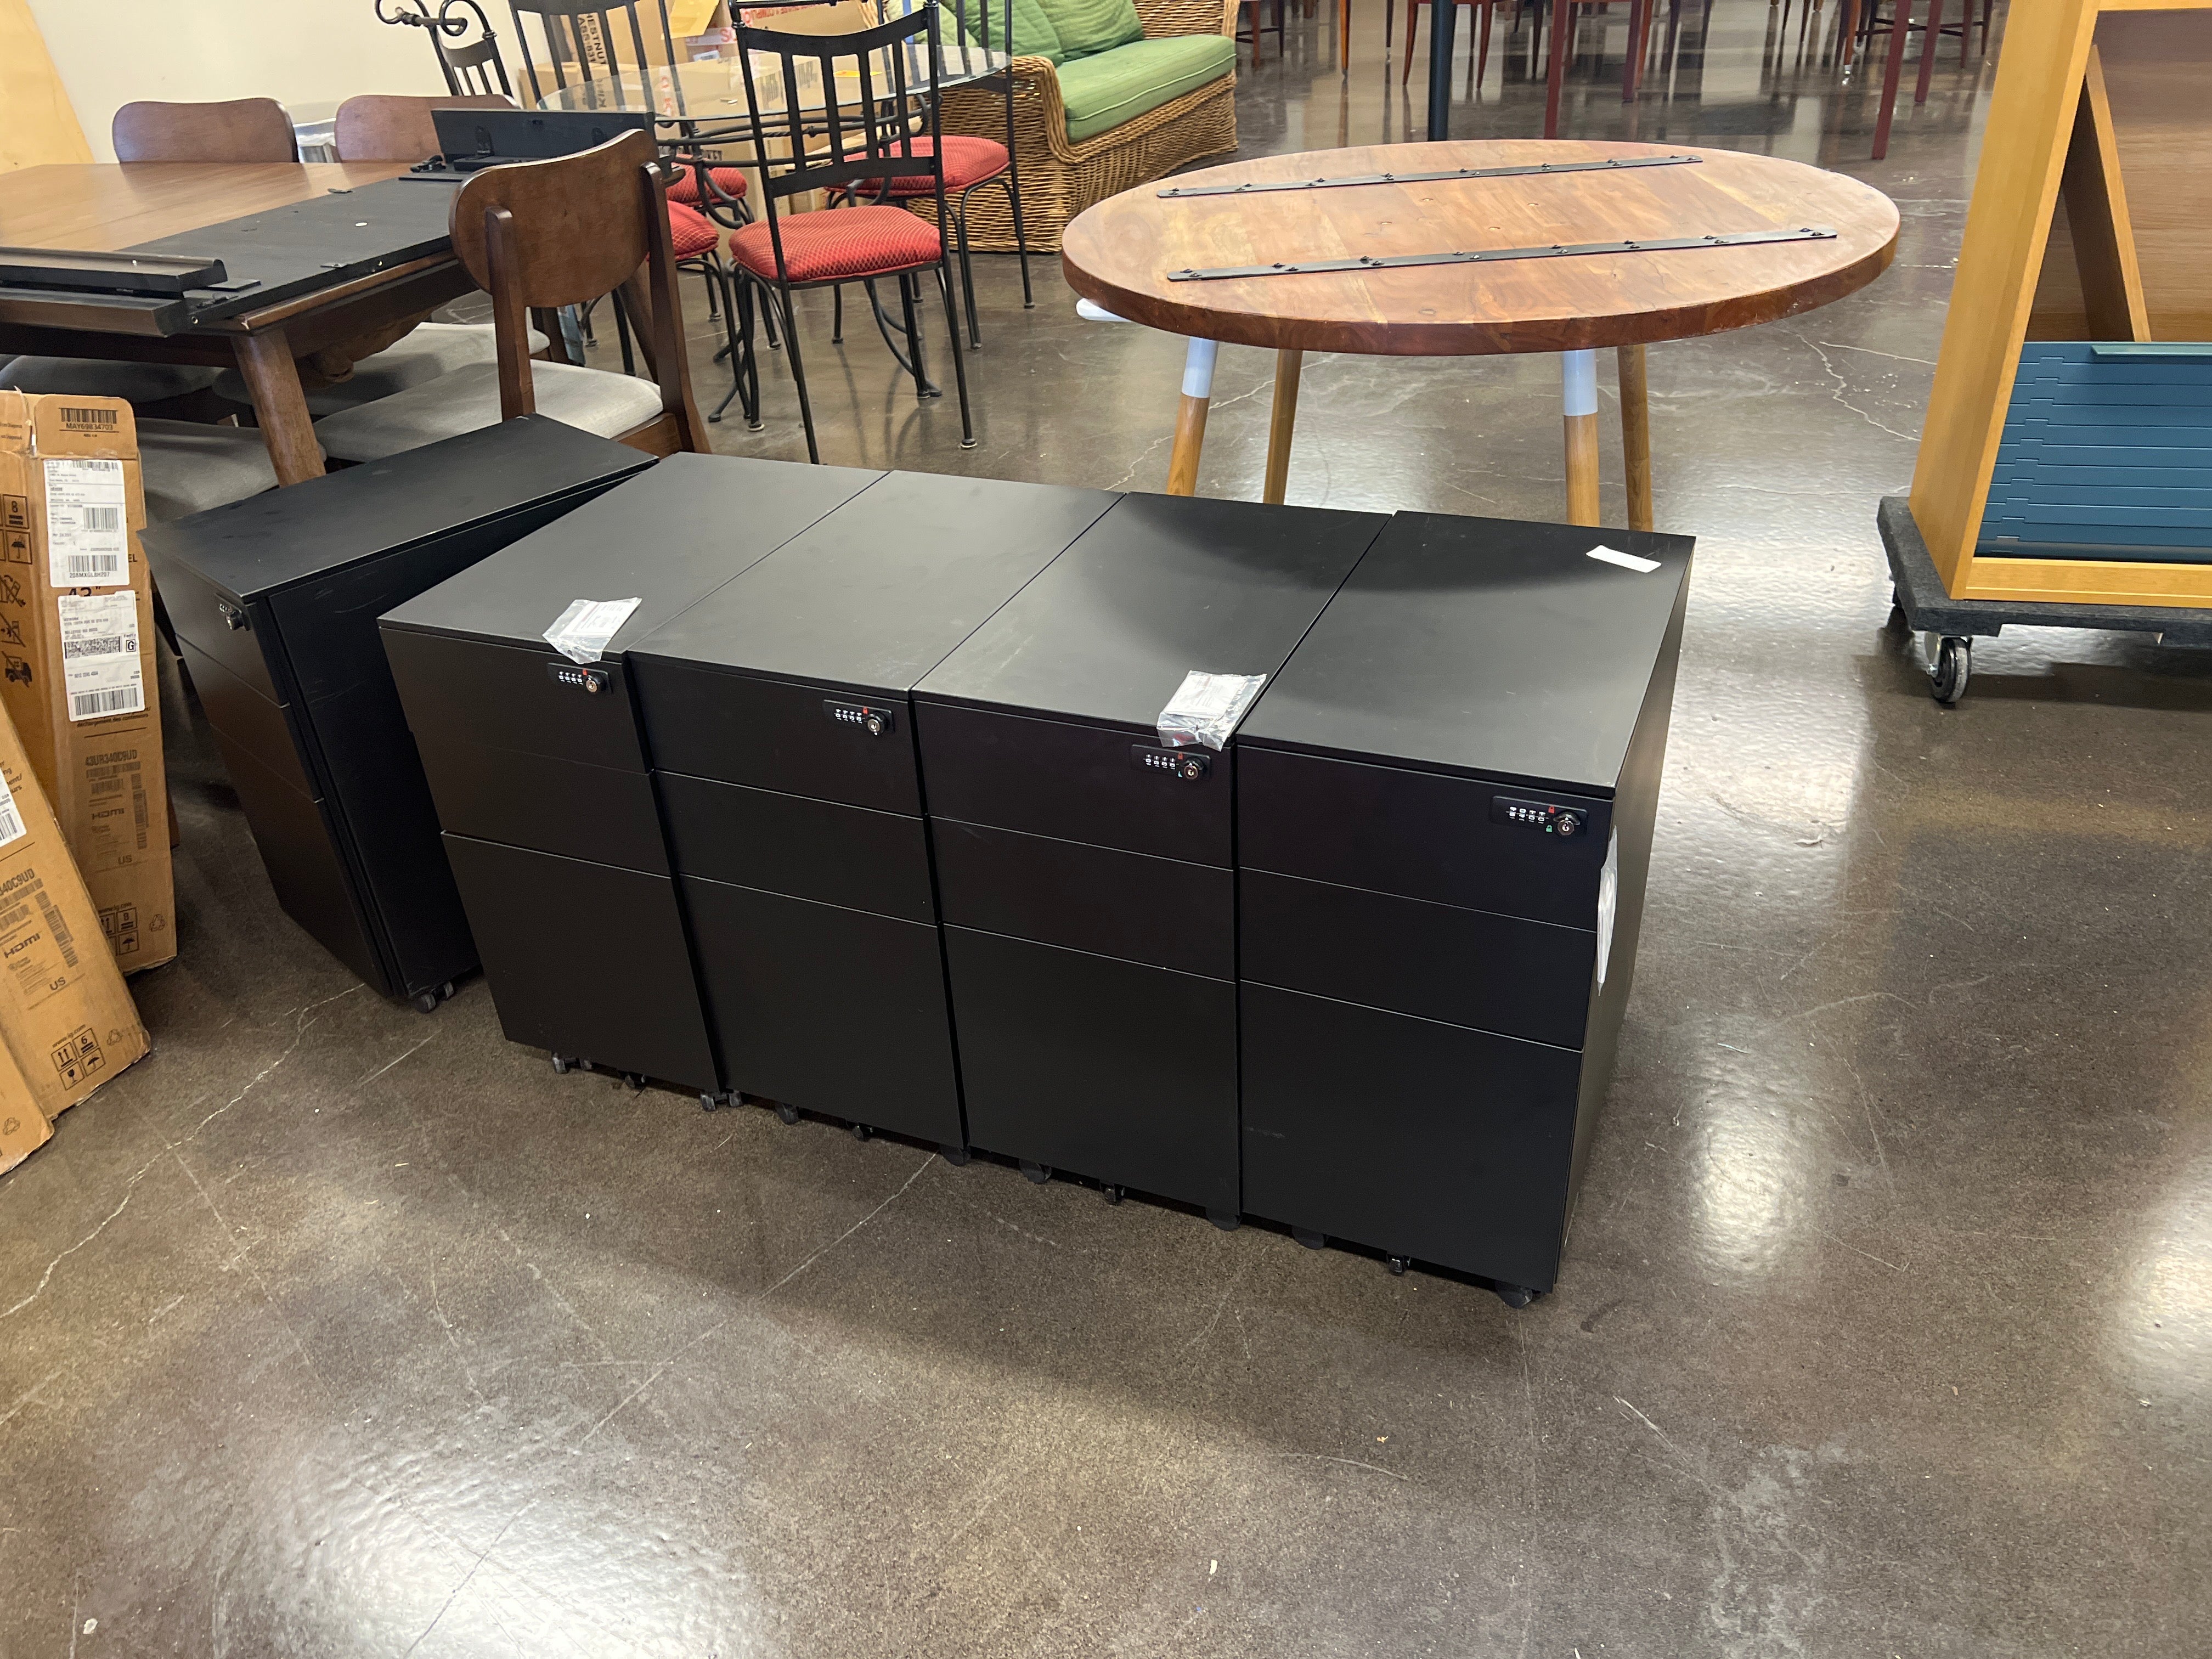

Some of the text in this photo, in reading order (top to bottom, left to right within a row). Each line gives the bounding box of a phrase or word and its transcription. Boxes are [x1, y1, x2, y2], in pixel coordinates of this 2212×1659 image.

[11, 500, 18, 513] 8
[127, 641, 134, 651] G
[92, 808, 125, 820] HDMI
[118, 854, 133, 865] US
[4, 932, 41, 958] HDMI
[49, 976, 66, 991] US
[81, 1036, 88, 1045] 6
